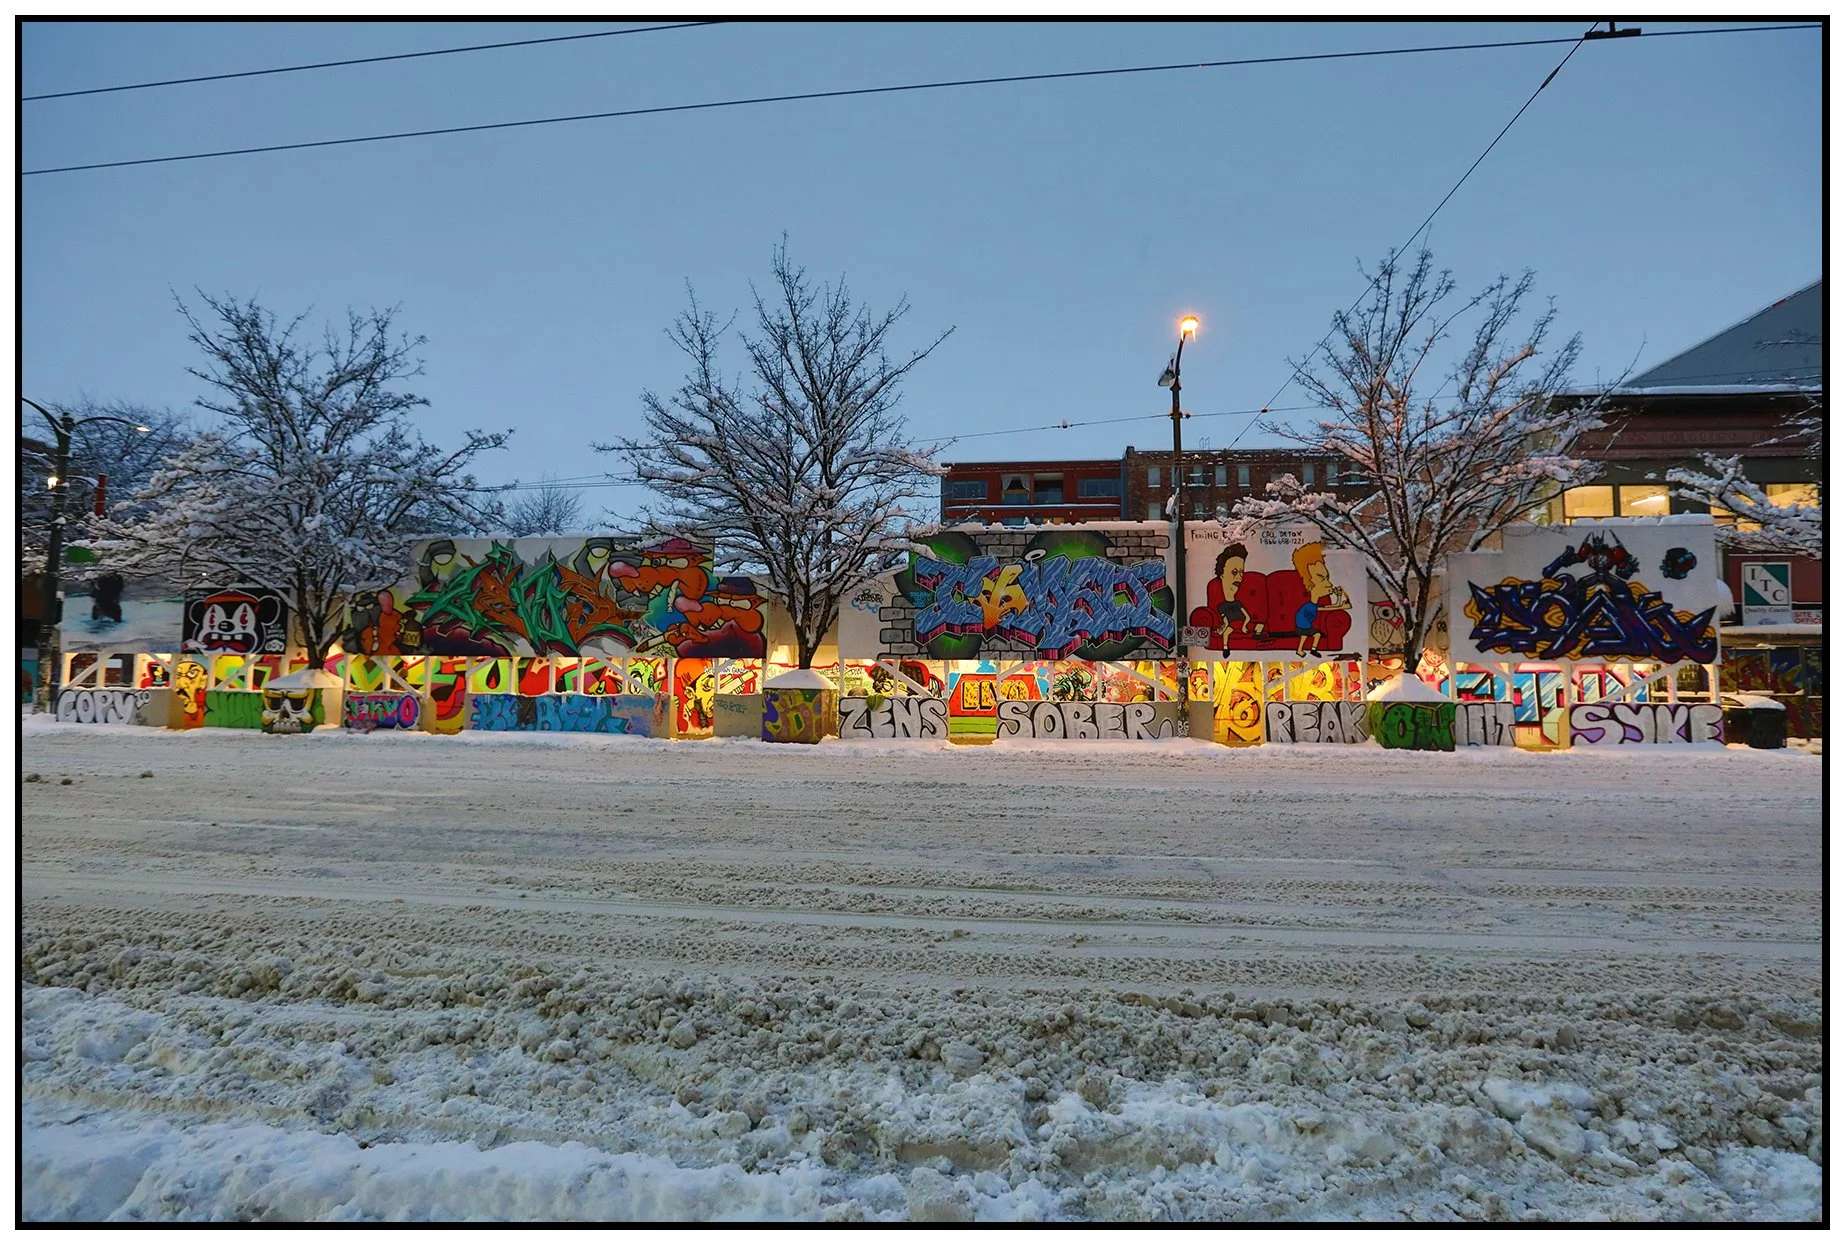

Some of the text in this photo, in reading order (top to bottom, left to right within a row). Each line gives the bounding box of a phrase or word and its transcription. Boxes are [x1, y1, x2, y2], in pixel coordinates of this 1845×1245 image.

[1279, 530, 1302, 538] DETOX
[839, 697, 949, 740] ZENS
[996, 700, 1175, 740] SOBER
[1570, 703, 1725, 745] SYKE
